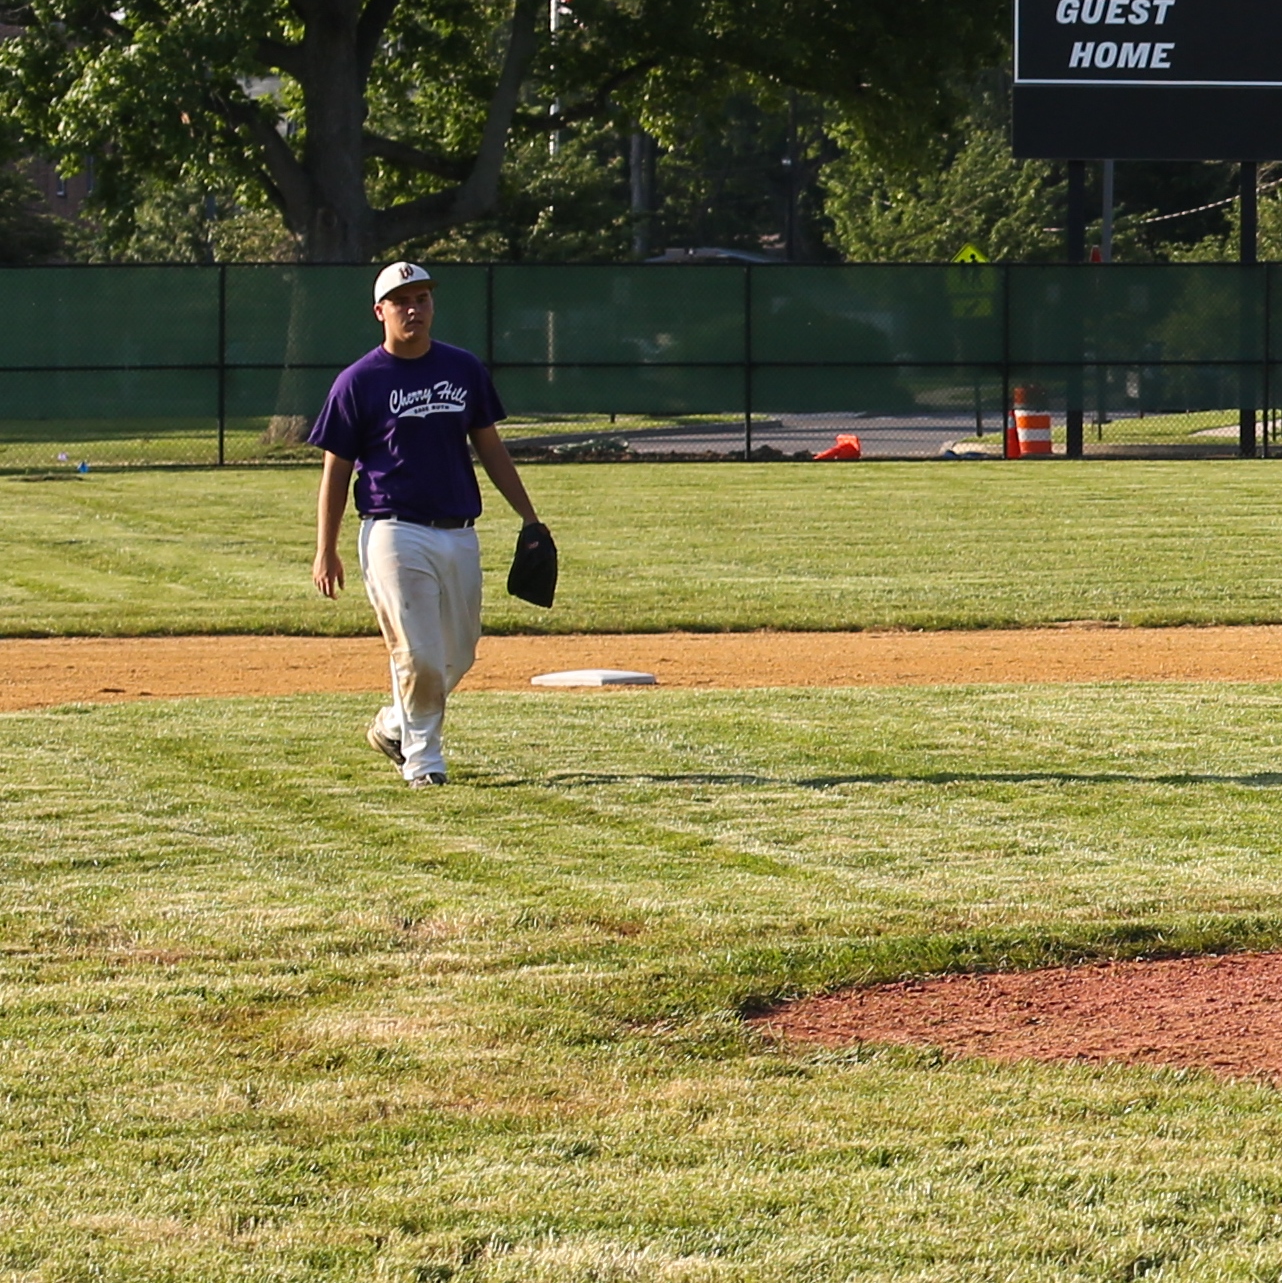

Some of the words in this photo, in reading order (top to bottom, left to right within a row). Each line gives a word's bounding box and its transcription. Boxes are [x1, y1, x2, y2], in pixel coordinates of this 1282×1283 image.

[1069, 42, 1174, 69] HOME
[390, 388, 432, 414] Cherry
[433, 380, 468, 403] Hill
